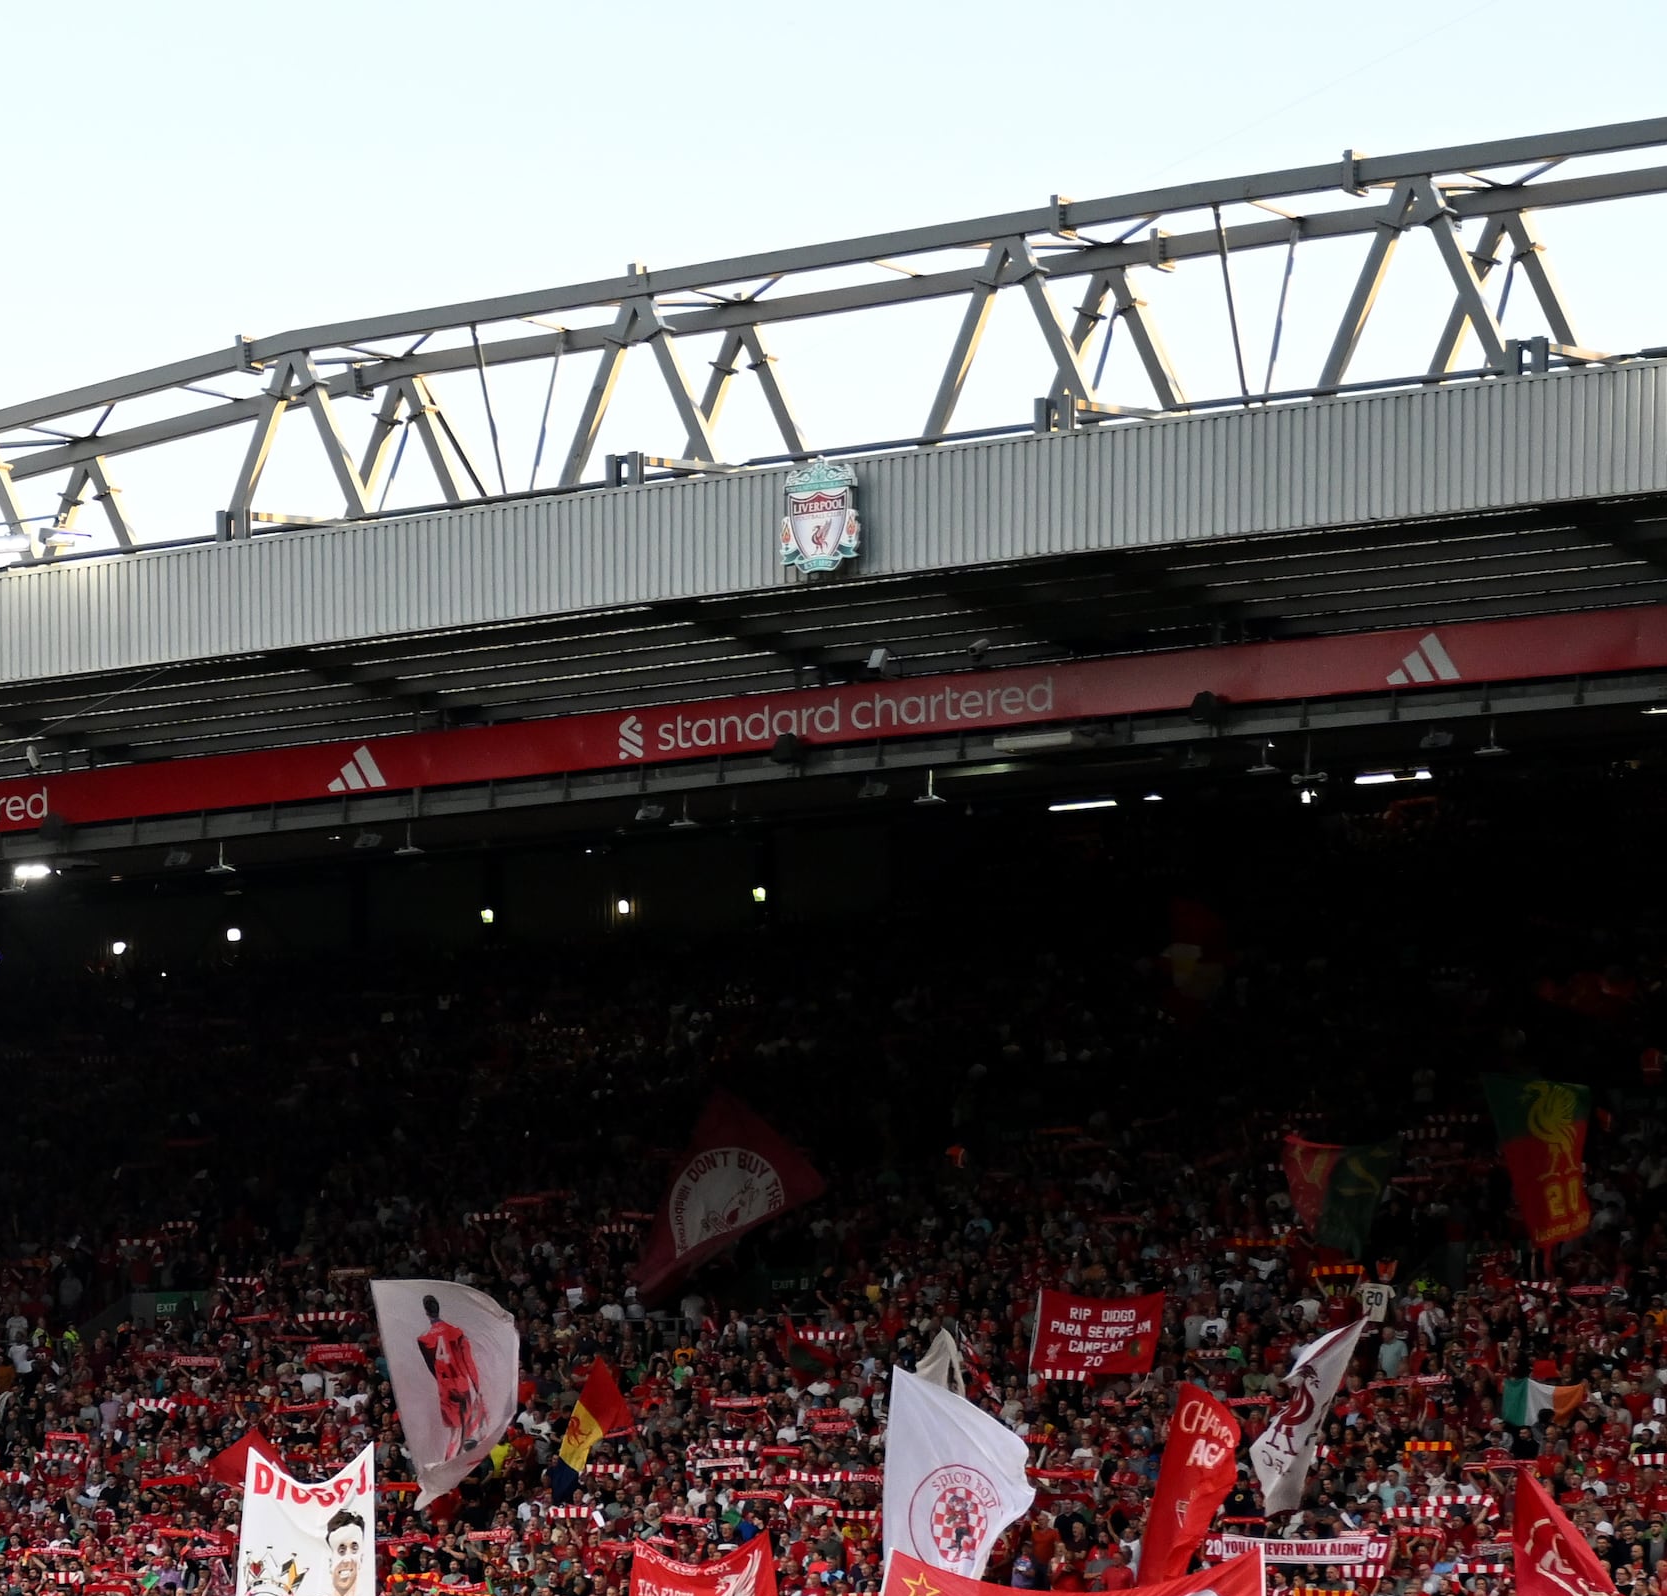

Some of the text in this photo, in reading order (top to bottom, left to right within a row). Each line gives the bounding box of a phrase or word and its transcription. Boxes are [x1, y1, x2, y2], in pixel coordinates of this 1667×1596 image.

[657, 676, 1053, 751] standard chartered
[686, 1150, 786, 1212] DON'T BUY THE
[1366, 1291, 1383, 1307] 20
[156, 1303, 178, 1314] EXIT
[1069, 1307, 1136, 1323] RIP DIOGO
[1050, 1321, 1134, 1340] PARA SEMPRE
[435, 1336, 449, 1362] 4
[1083, 1355, 1104, 1368] 20
[1205, 1542, 1387, 1560] 20 WALK ALONE 97
